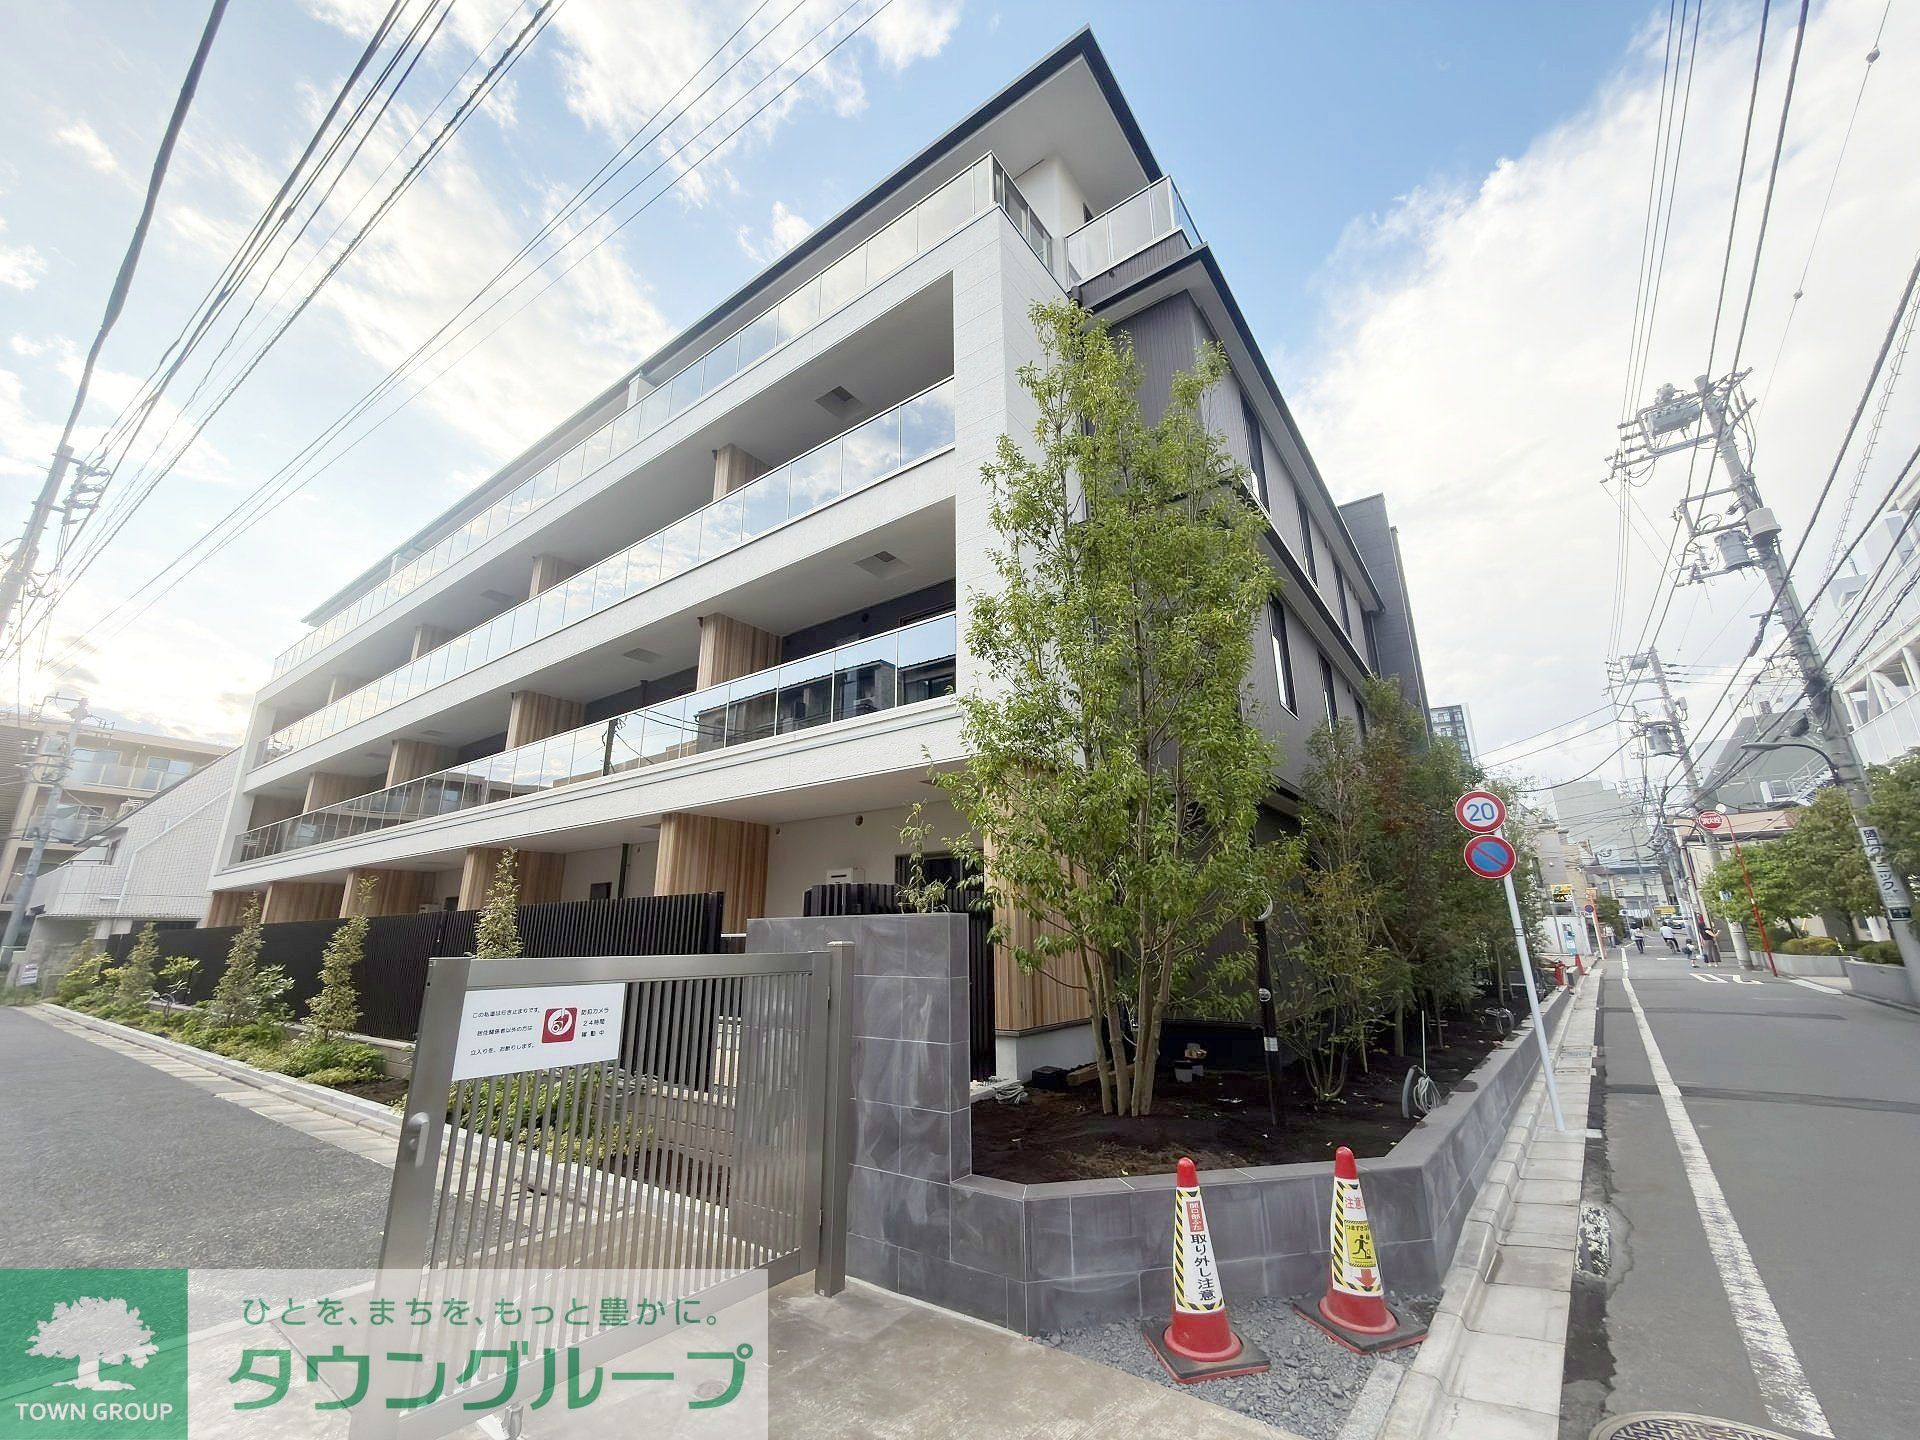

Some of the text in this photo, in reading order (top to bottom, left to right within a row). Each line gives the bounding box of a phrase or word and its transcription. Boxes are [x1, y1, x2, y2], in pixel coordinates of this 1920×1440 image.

[1467, 803, 1494, 821] 20
[581, 1007, 609, 1015] 防犯カメラ
[1345, 1196, 1365, 1209] 注意
[1190, 1234, 1216, 1301] 取り外し注意
